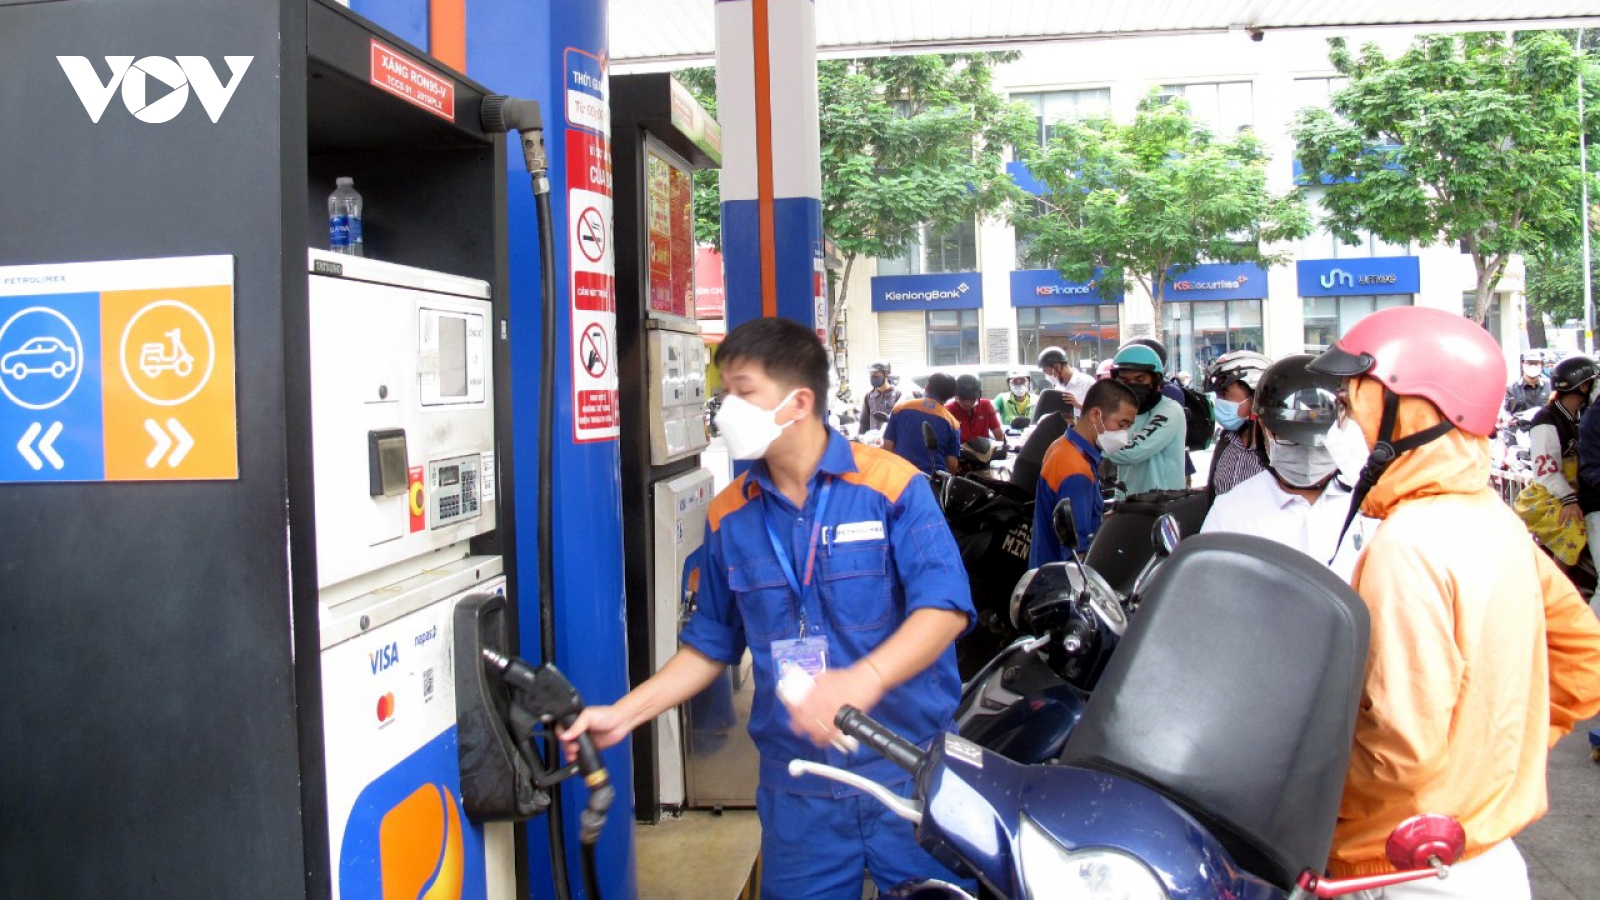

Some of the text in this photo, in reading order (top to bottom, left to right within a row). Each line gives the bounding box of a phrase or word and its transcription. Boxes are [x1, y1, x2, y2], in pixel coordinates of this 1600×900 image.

[381, 55, 408, 79] XĂNG
[387, 75, 404, 91] TCCS
[4, 275, 66, 285] PETROLIMEX
[885, 289, 960, 301] KienlongBank
[1036, 285, 1089, 295] KSFinance
[1535, 454, 1559, 476] 23
[370, 640, 399, 676] VISA
